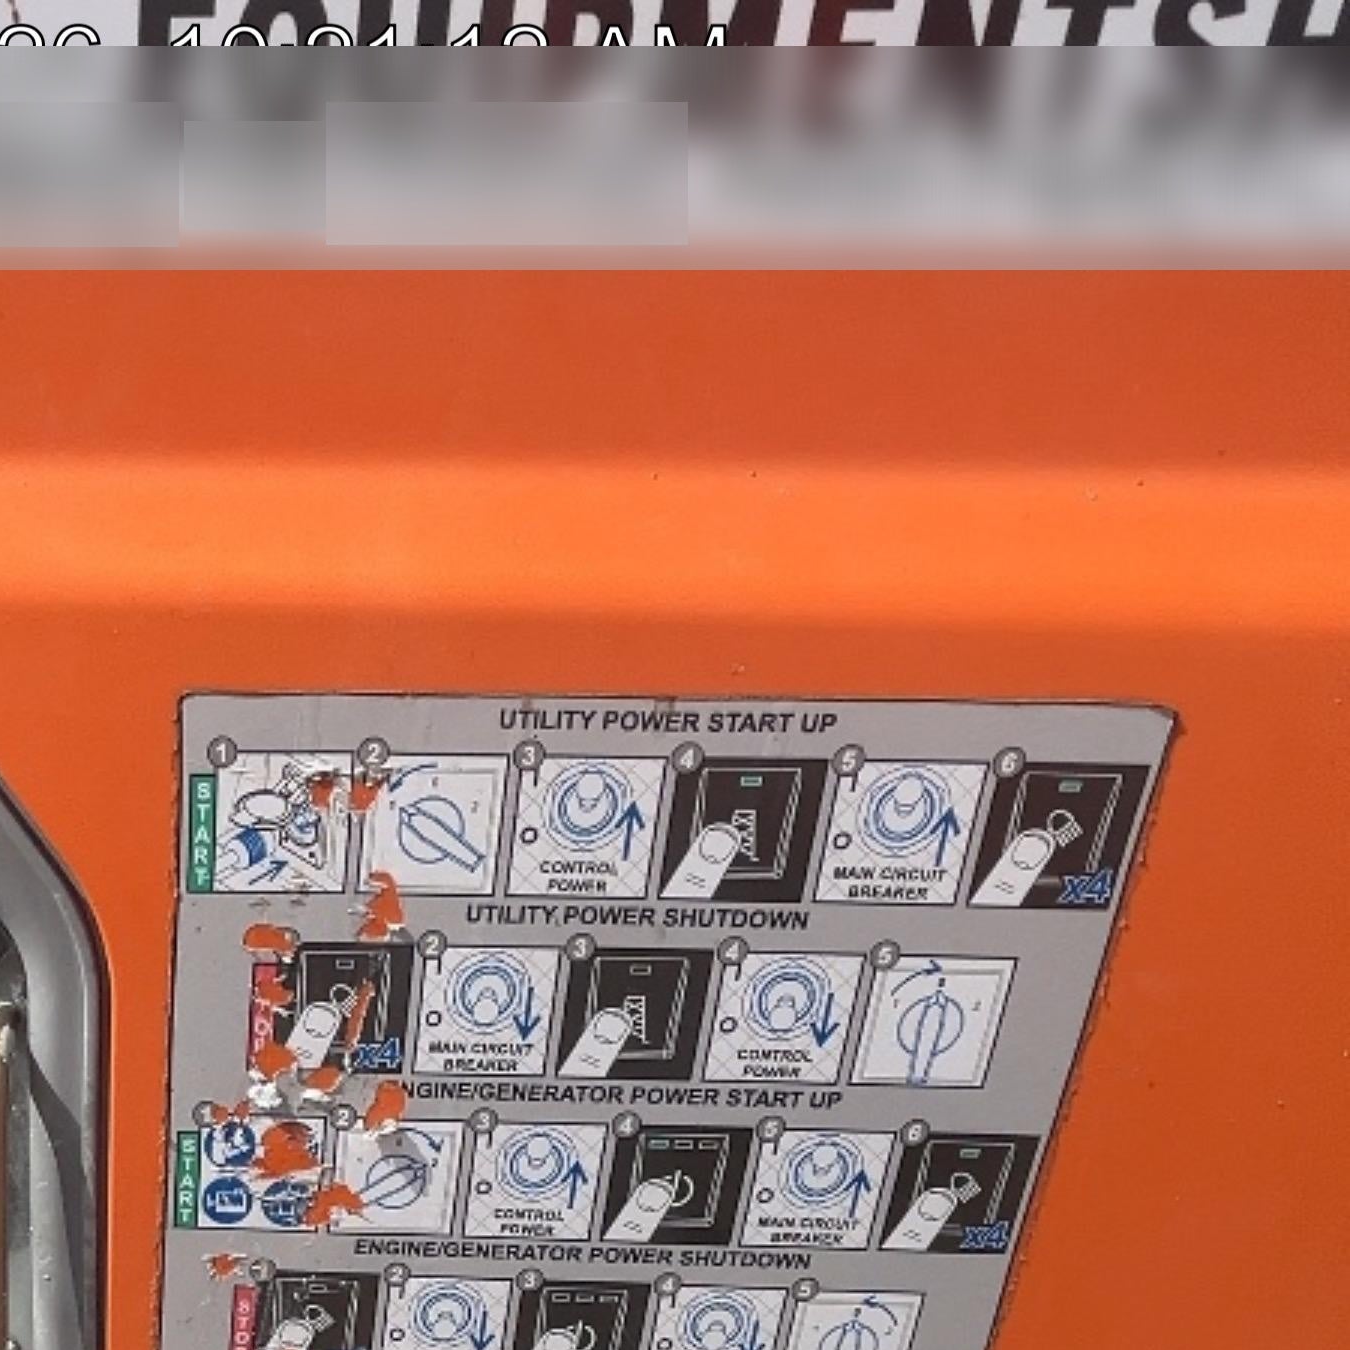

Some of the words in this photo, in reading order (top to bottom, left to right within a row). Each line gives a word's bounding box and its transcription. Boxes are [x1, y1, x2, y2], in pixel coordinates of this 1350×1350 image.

[499, 709, 597, 730] UTILITY
[601, 711, 700, 732] POWER
[707, 712, 795, 733] START
[800, 713, 838, 733] UP
[194, 782, 211, 886] START
[539, 860, 618, 877] CONTROL
[833, 865, 876, 881] MAIN
[879, 866, 948, 883] CIRCUIT
[546, 879, 607, 894] POWER
[848, 884, 929, 900] BREAKER
[1061, 869, 1115, 904] x4
[465, 904, 557, 925] UTILITY
[563, 906, 655, 927] POWER
[662, 907, 811, 930] SHUTDOWN
[354, 1037, 402, 1069] x4
[428, 1041, 467, 1054] MAIN
[471, 1043, 535, 1057] CIRCUIT
[737, 1049, 814, 1064] CONTROL
[443, 1058, 518, 1073] BREAKER
[742, 1065, 801, 1079] POWER
[400, 1081, 625, 1105] NGINE/GENERATOR
[632, 1083, 719, 1106] POWER
[725, 1085, 801, 1108] START
[808, 1087, 843, 1109] UP
[179, 1138, 196, 1223] START
[493, 1208, 565, 1223] CONTROL
[353, 1239, 584, 1263] ENGINE/GENERATOR
[588, 1247, 673, 1267] POWER
[679, 1250, 813, 1270] SHUTDOWN
